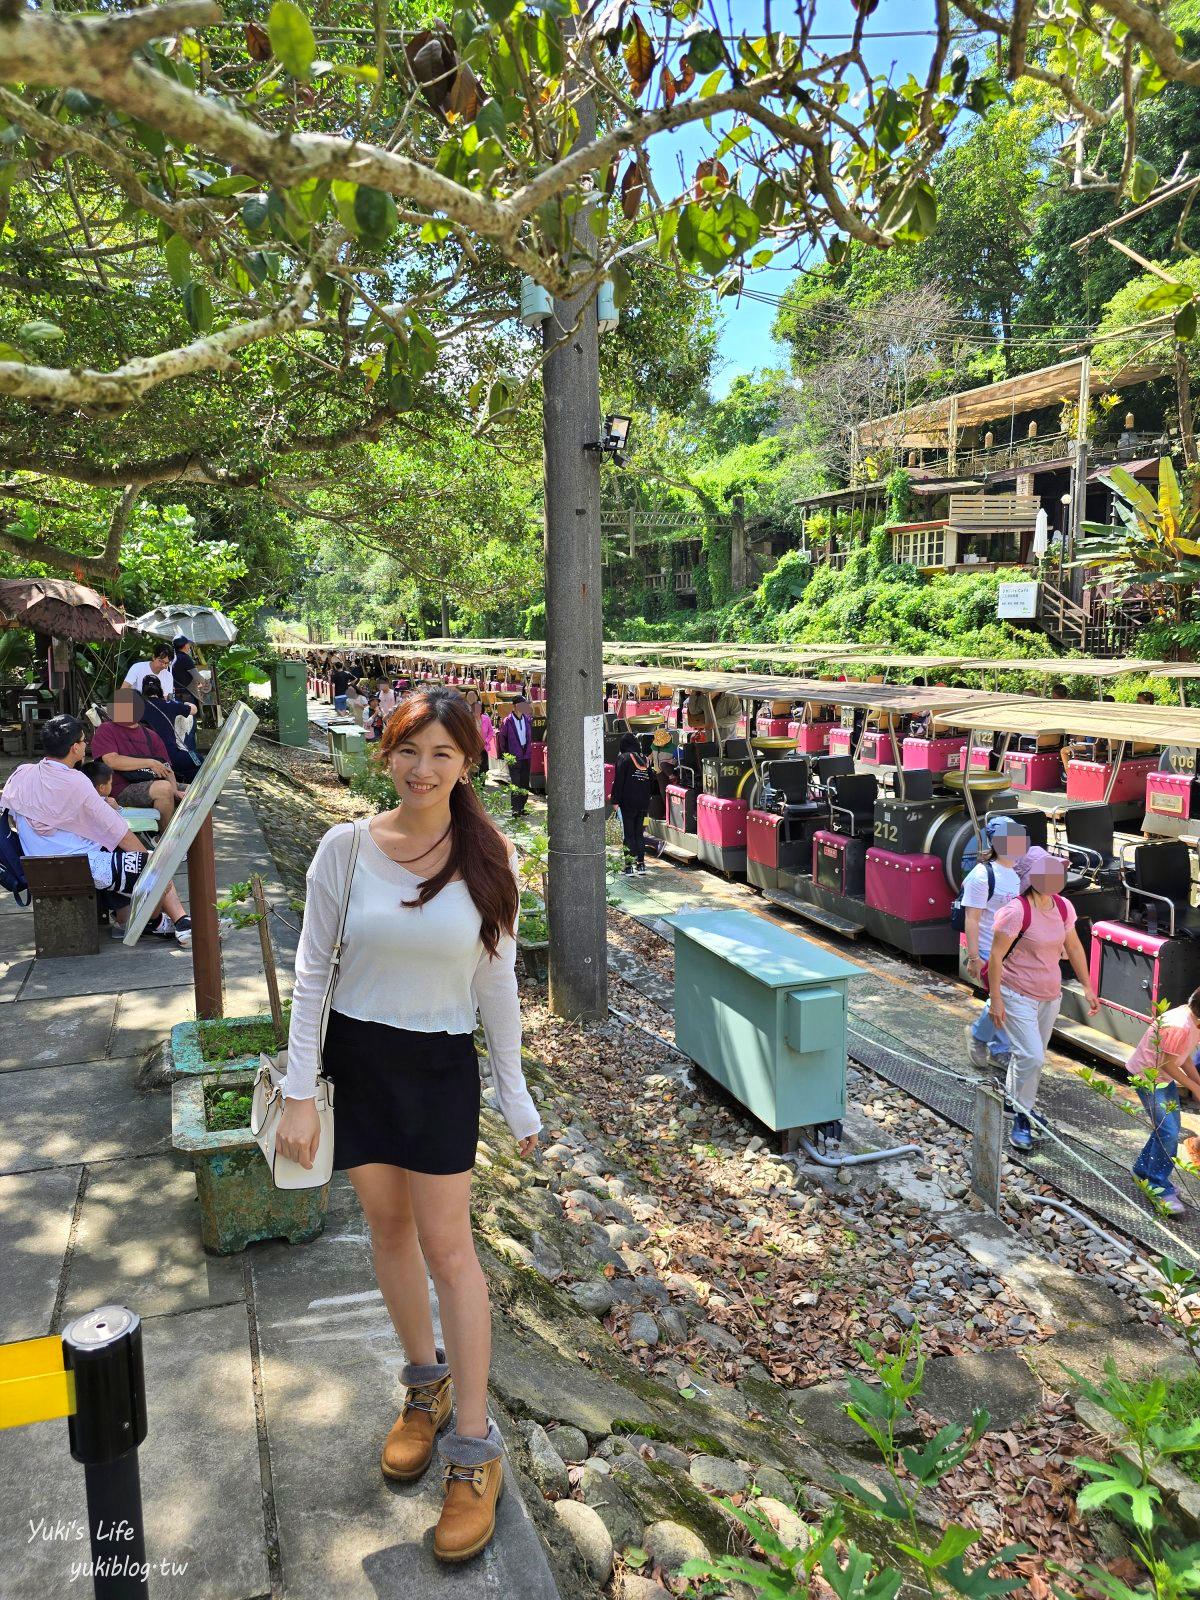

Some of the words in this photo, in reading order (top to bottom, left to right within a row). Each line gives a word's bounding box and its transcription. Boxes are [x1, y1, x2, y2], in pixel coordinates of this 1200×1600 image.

[1172, 755, 1195, 769] 106
[721, 765, 740, 777] 151
[874, 821, 898, 842] 212
